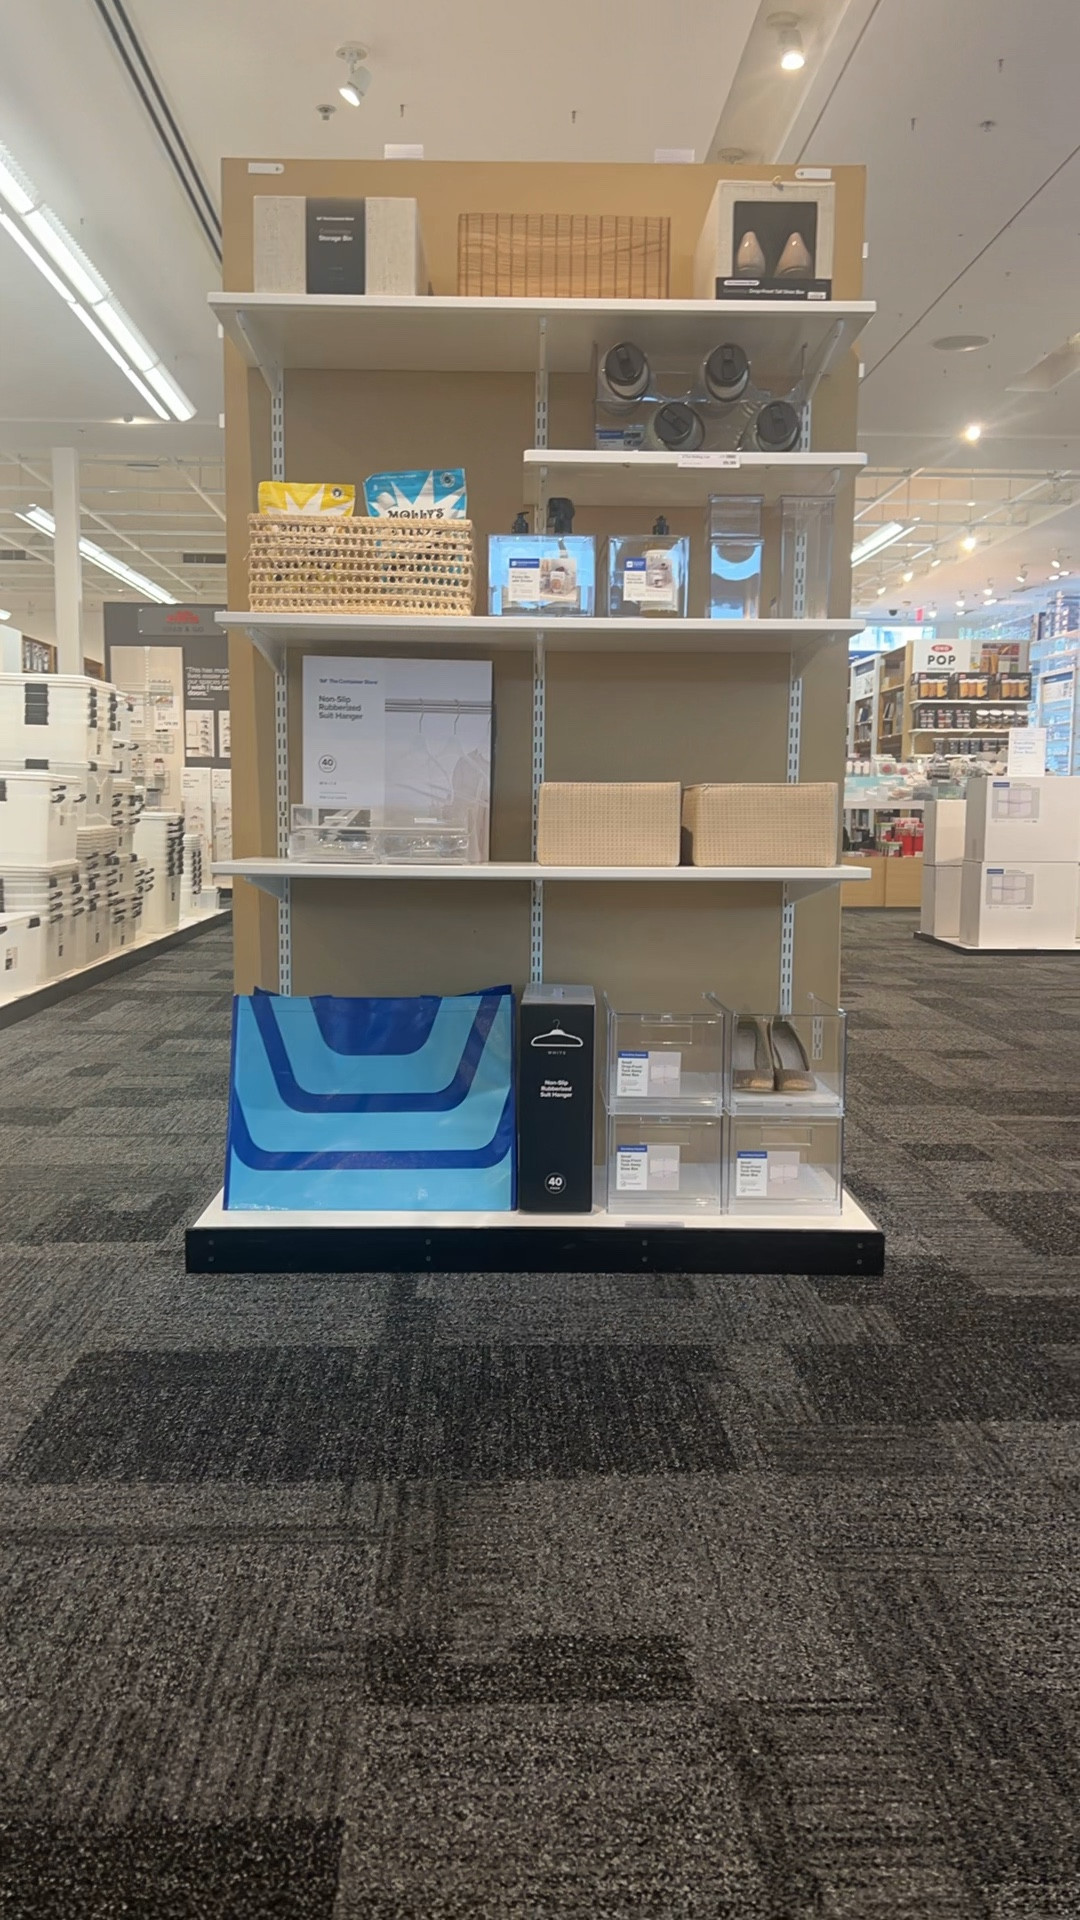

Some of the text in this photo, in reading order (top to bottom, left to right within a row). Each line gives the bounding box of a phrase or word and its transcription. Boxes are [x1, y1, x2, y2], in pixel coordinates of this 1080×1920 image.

[318, 235, 342, 243] Storage
[927, 655, 956, 665] POP
[319, 695, 351, 705] Non-Slip
[319, 703, 362, 711] Rubberized
[319, 711, 363, 721] Suit Hanger
[321, 758, 334, 766] 40
[548, 1177, 563, 1187] 40
